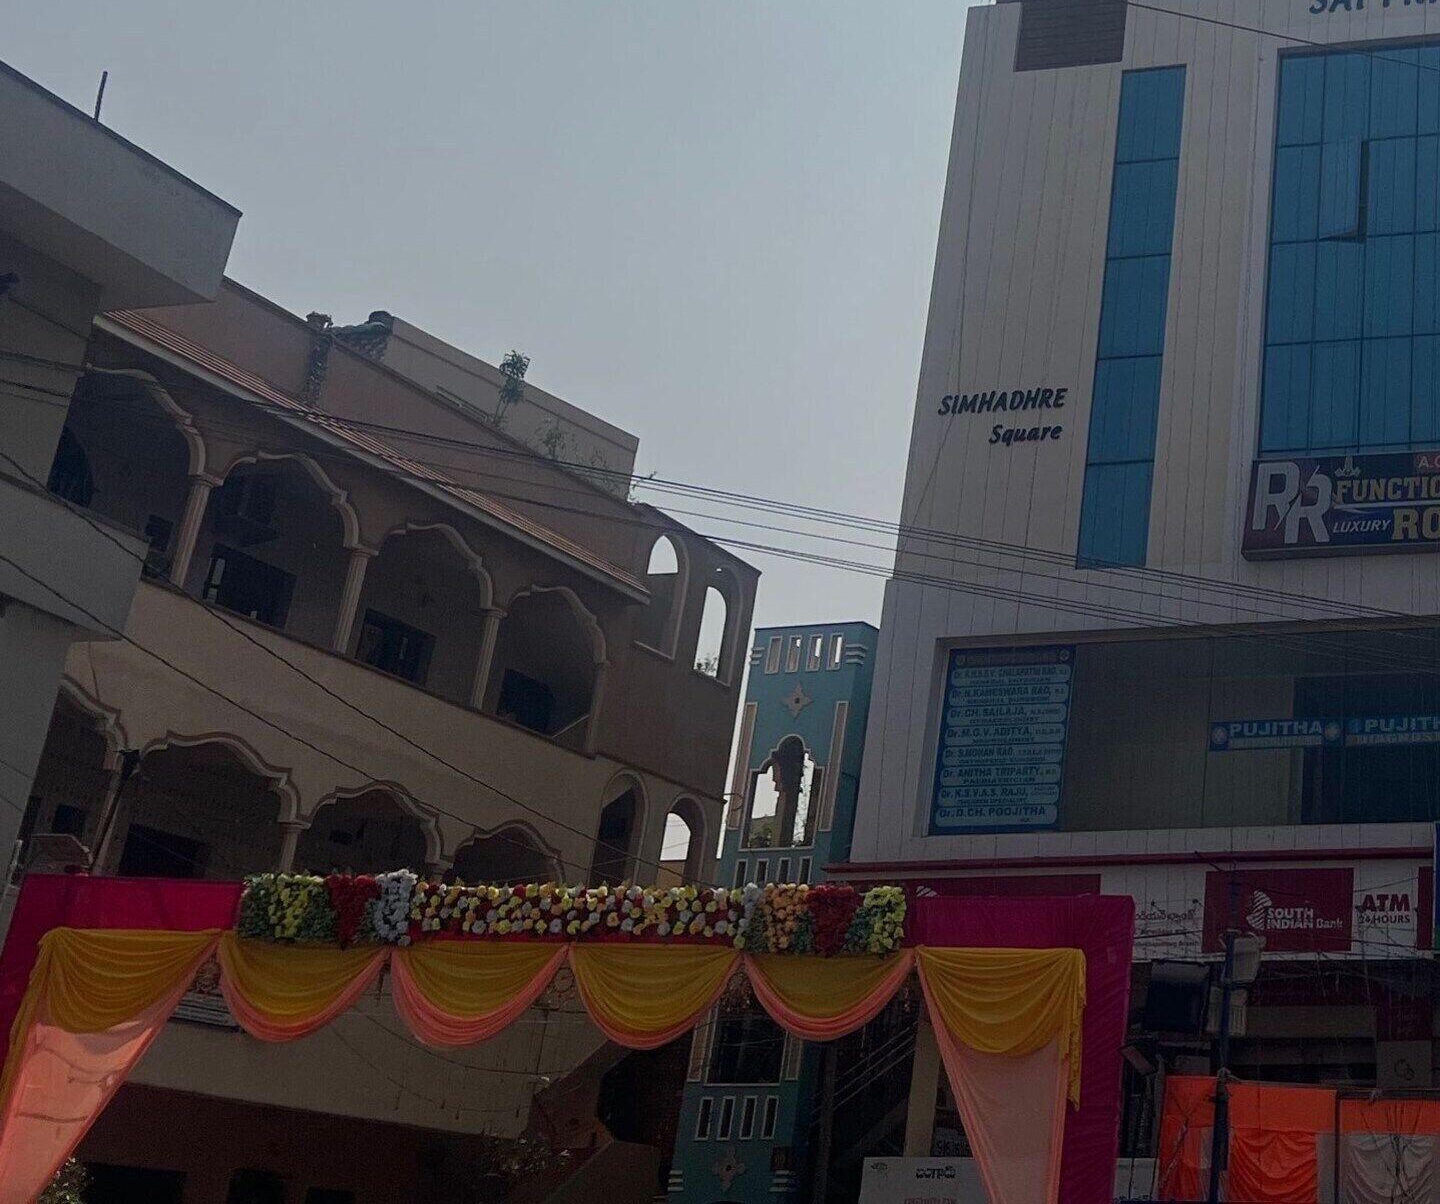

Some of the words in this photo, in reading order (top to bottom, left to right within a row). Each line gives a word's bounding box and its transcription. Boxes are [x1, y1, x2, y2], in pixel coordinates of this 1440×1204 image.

[938, 387, 1068, 415] SIMHADHRE
[989, 424, 1063, 446] Square
[1332, 519, 1391, 533] LUXURY
[1229, 721, 1323, 736] PUJITHA
[988, 804, 1046, 816] POOJITHA
[1362, 894, 1410, 912] ATM
[1267, 908, 1314, 919] SOUTH
[1266, 918, 1314, 930] INDIAN
[1316, 917, 1344, 929] Bank
